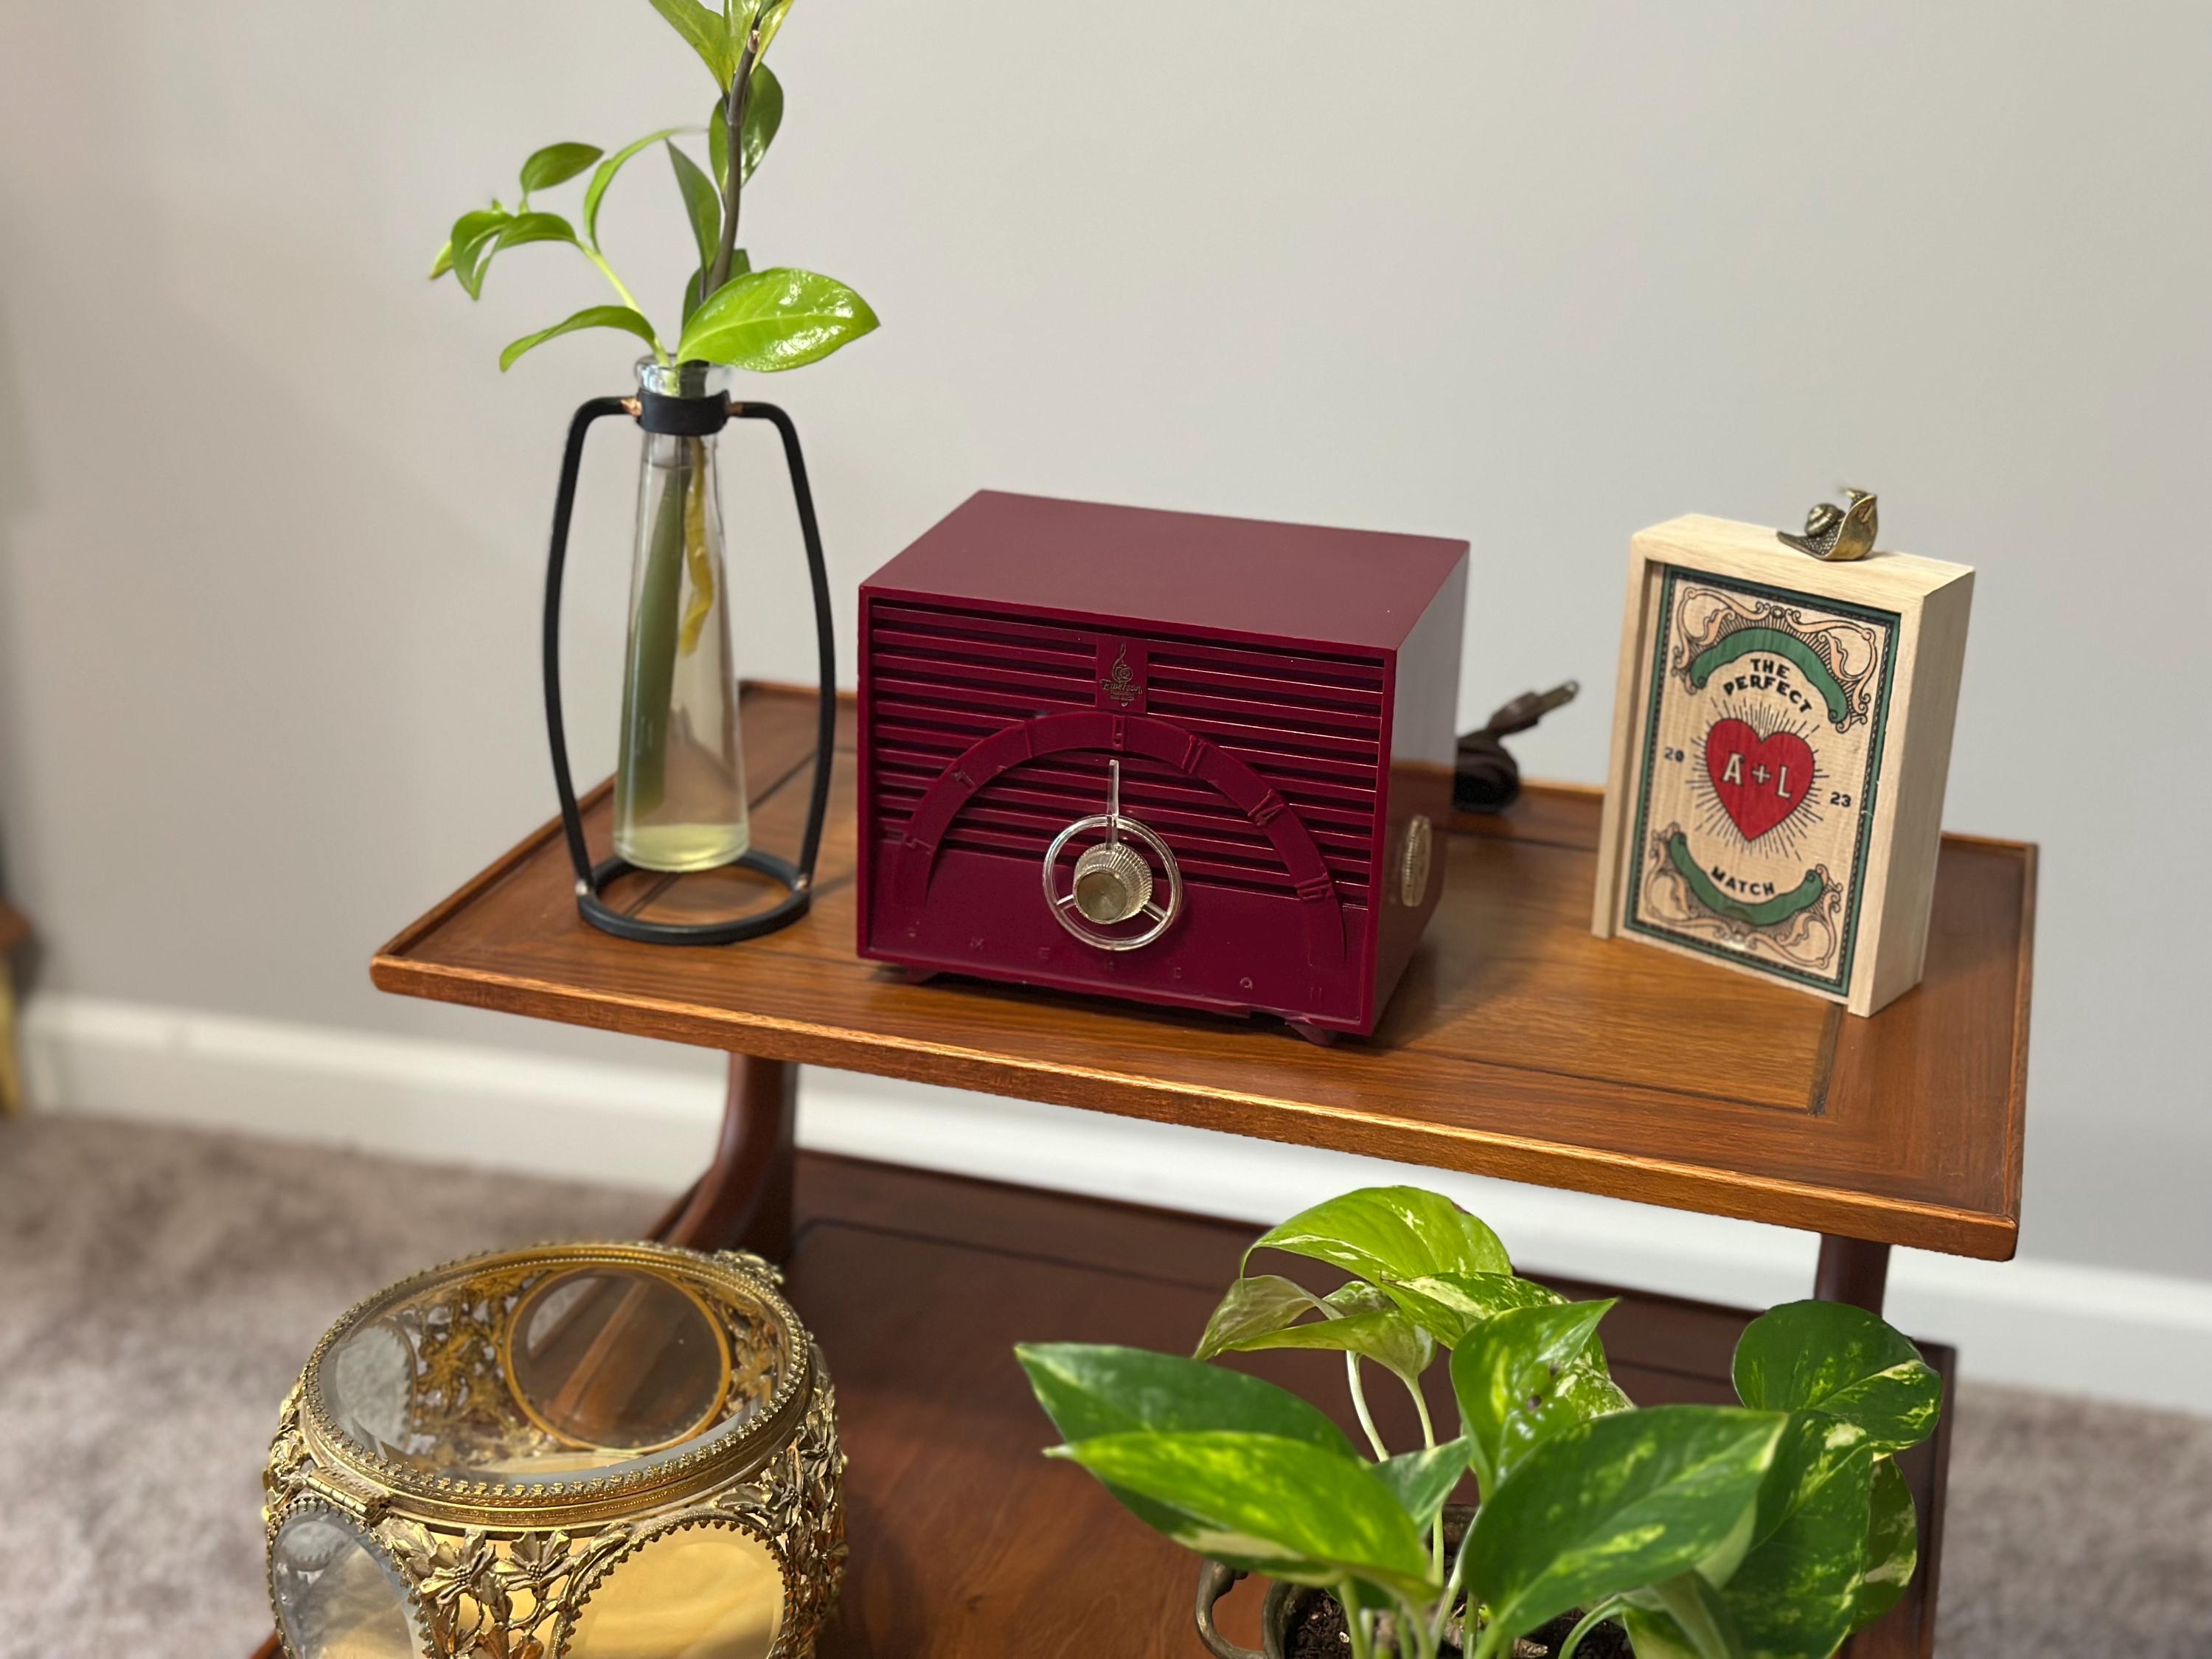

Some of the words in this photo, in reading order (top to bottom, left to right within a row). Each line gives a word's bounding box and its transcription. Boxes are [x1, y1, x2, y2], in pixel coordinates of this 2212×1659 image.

[1750, 658, 1790, 679] THE
[1723, 674, 1812, 713] PERFECT
[1664, 748, 1684, 763] 20
[1830, 792, 1851, 808] 23
[1711, 866, 1775, 896] MATCH
